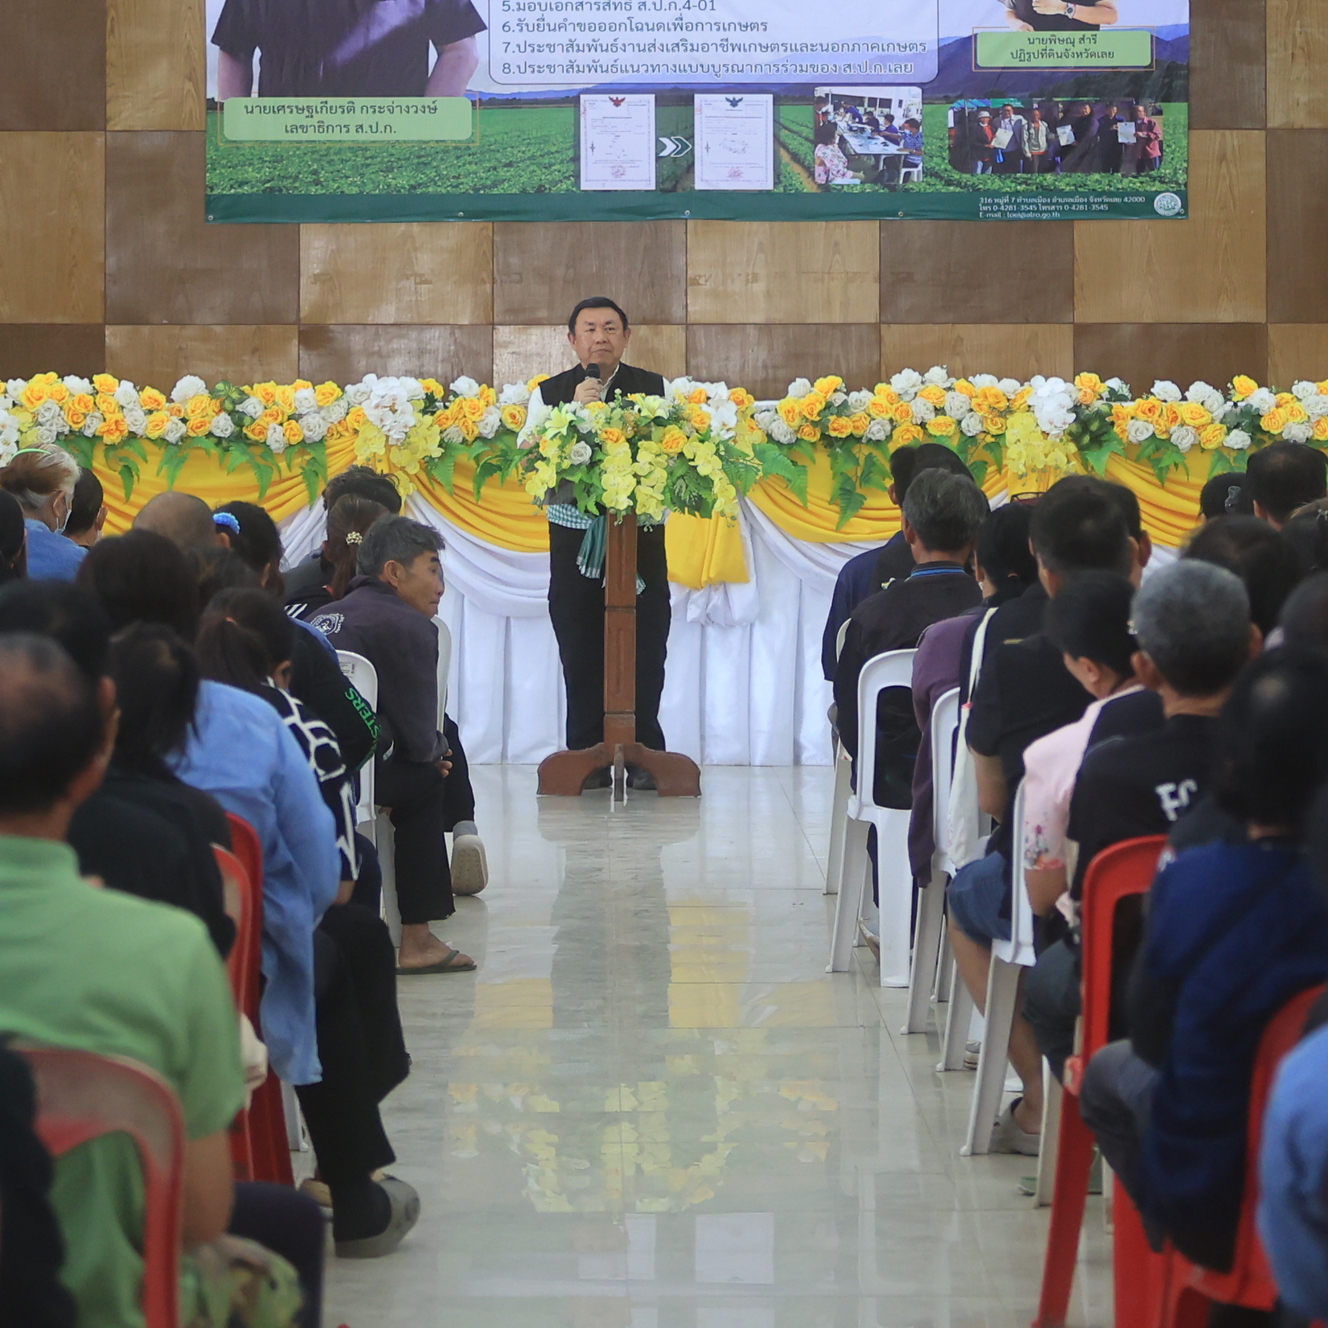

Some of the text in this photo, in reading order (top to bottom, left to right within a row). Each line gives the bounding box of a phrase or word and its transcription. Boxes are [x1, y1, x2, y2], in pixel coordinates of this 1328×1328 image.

[501, 13, 768, 33] 6.รับยื่นคำขอออกโฉนดเพื่อการเกษตร
[1027, 33, 1076, 47] นายพิษณุ
[1010, 46, 1115, 62] ปฏิรูปที่ดินจังหวัดเลย
[842, 60, 914, 75] ส.ป.ก.เลย
[244, 100, 438, 118] นายเศรษฐเกียรติ กระจ่างวงษ์
[284, 121, 397, 134] เลขาธิการ ส.ป.ก.
